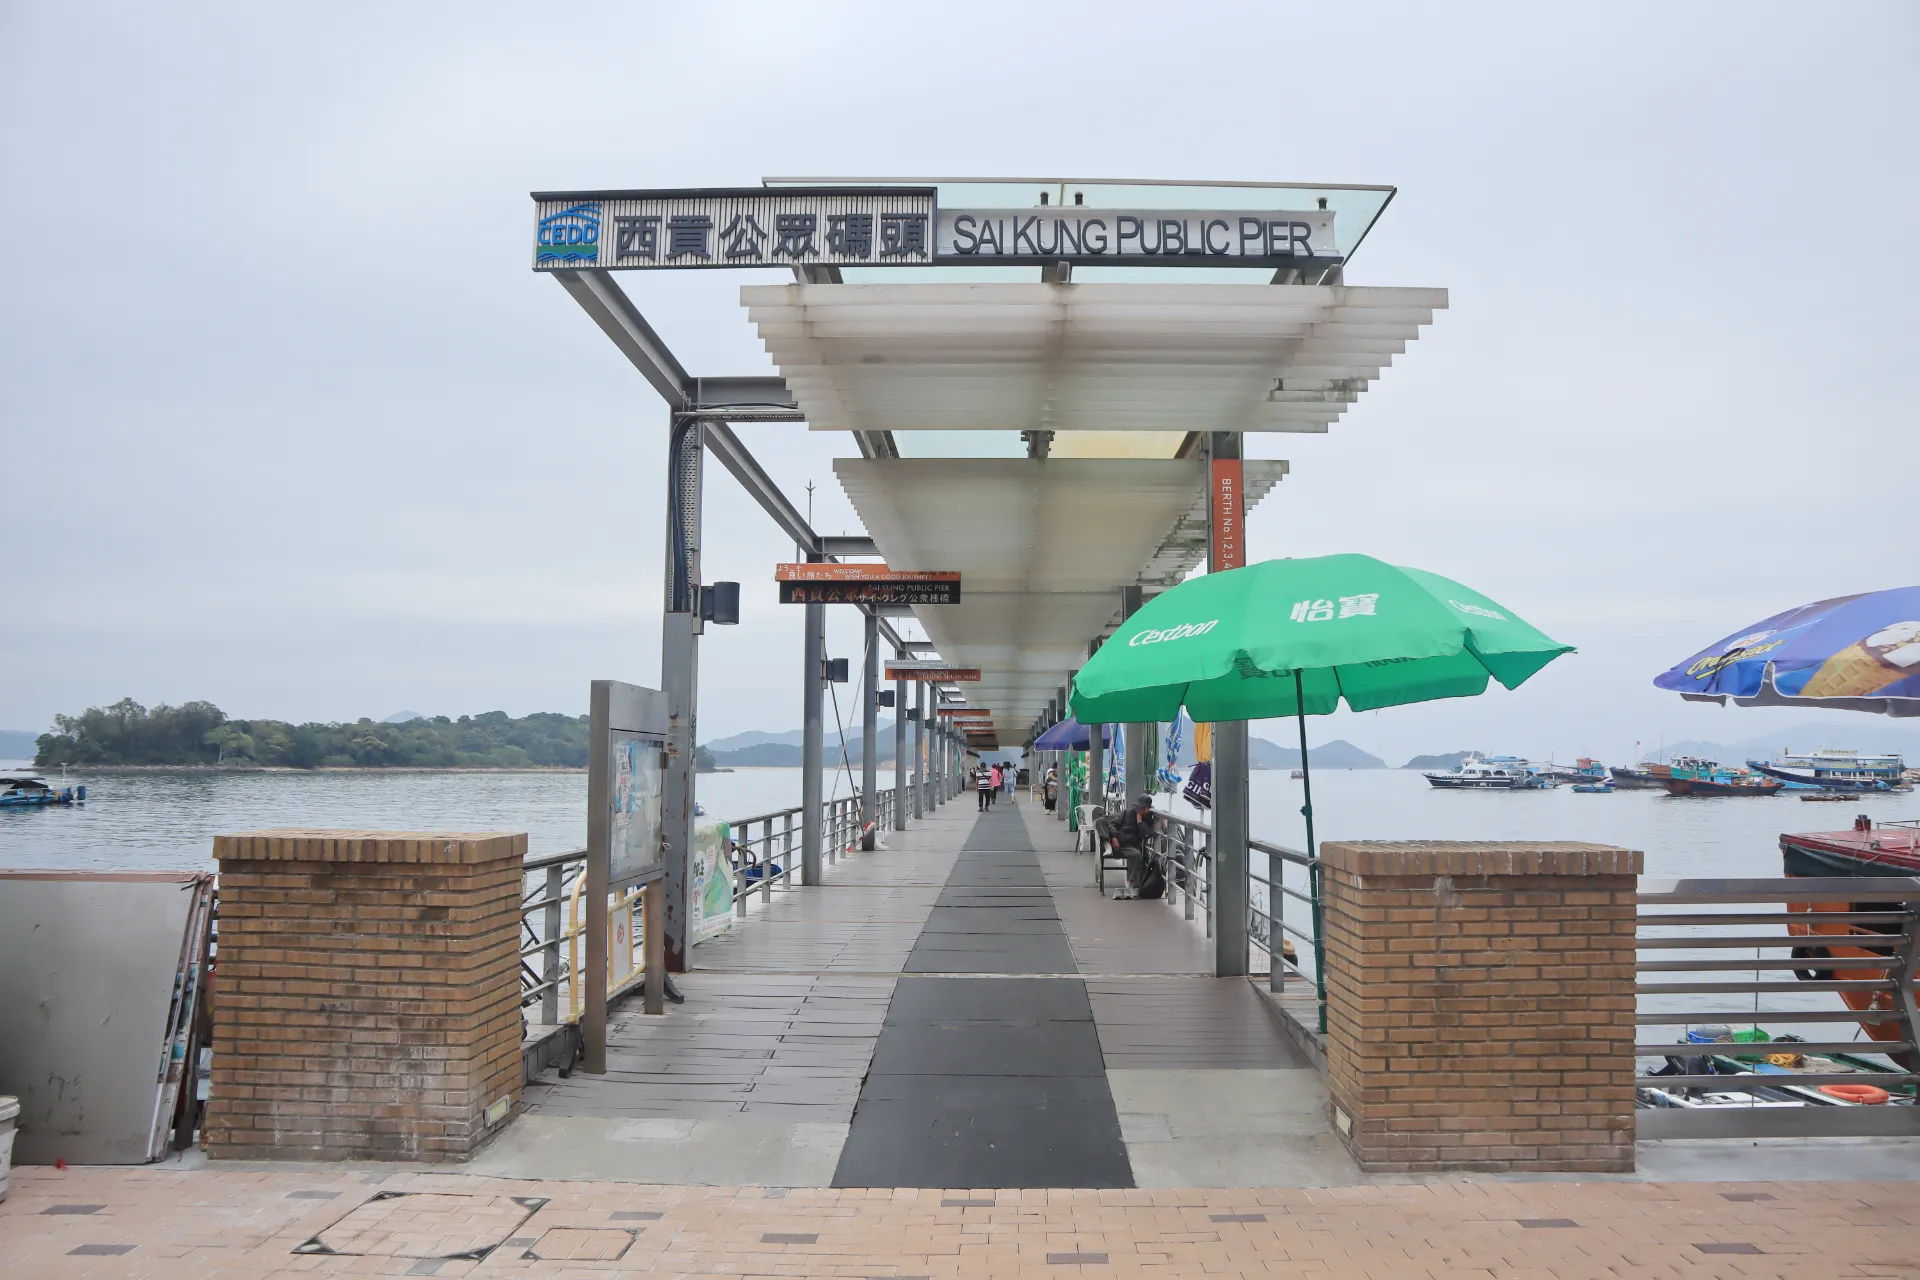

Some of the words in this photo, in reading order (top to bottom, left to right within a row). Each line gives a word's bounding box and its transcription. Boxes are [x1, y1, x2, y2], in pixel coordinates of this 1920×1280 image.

[538, 224, 599, 245] CEDD
[613, 212, 929, 260] 西貢公眾碼頭
[952, 214, 1004, 255] SAI
[1013, 215, 1106, 255] KUNG
[1116, 215, 1231, 256] PUBLIC
[1239, 216, 1314, 257] PIER
[1222, 478, 1232, 515] BERTH
[777, 564, 803, 572] ようこそ
[907, 584, 933, 592] PUBLIC
[934, 584, 950, 592] PIER
[1289, 593, 1380, 623] 怡寶
